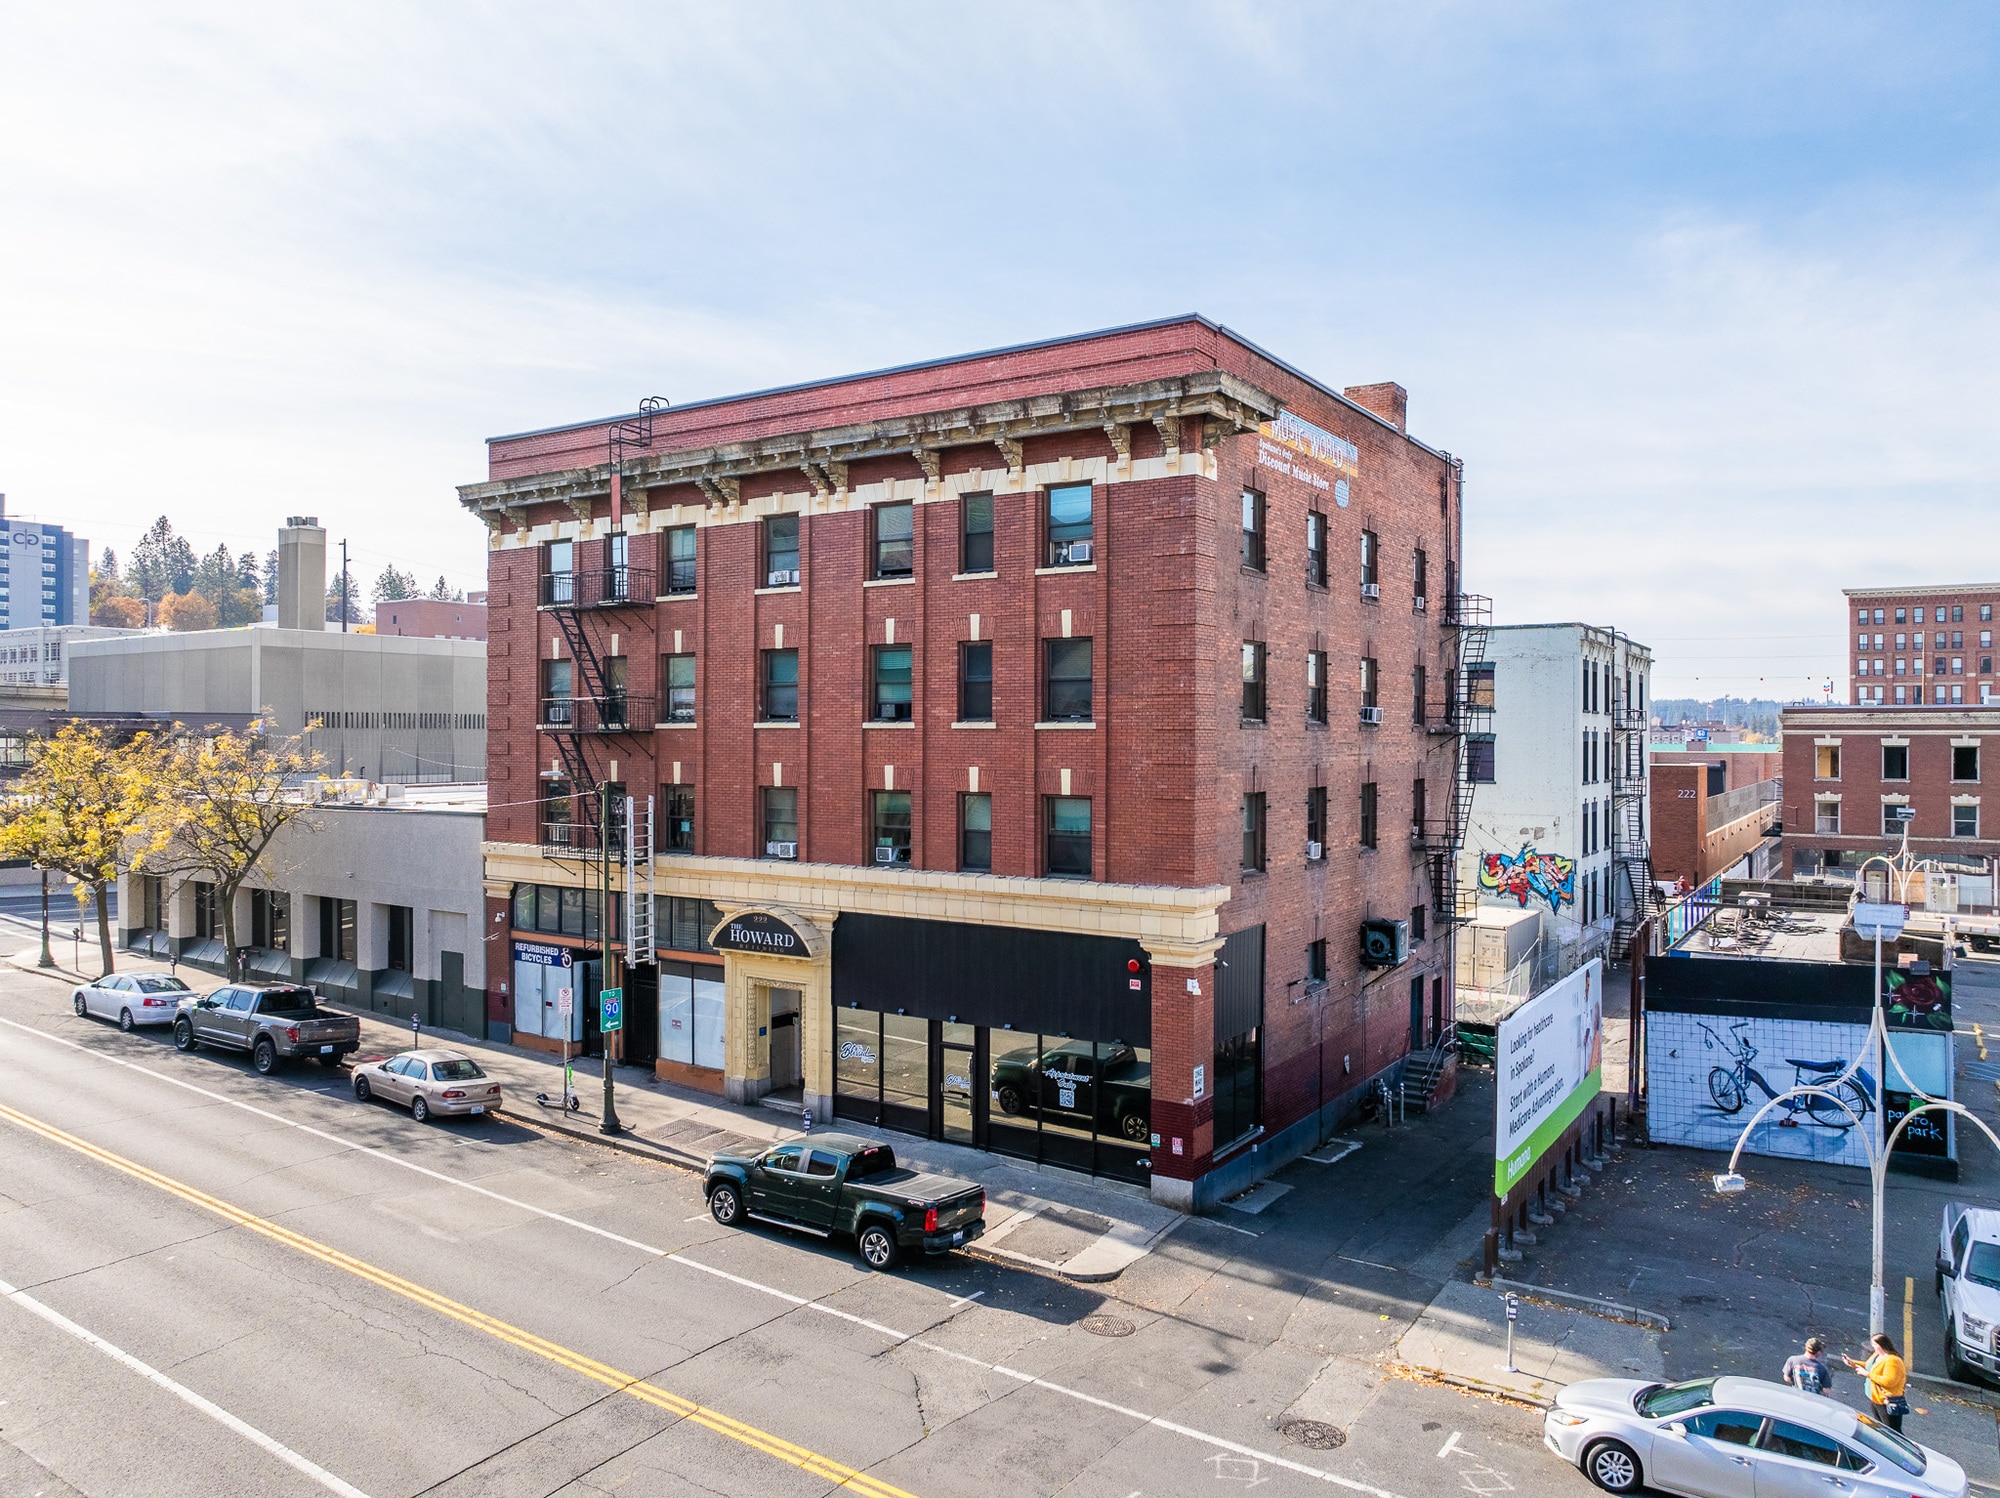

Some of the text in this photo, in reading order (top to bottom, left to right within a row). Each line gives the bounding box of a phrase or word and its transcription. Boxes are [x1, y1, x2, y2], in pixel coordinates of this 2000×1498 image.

[1271, 417, 1343, 469] MUSIC WORLD
[1281, 448, 1293, 462] Only
[1259, 448, 1329, 490] Discount Music Store
[1677, 789, 1696, 799] 222
[753, 915, 768, 923] 222
[730, 929, 794, 948] HOWARD
[515, 942, 559, 956] REFURBISHED
[740, 944, 784, 953] BUILDING
[521, 952, 552, 965] BICYCLES
[605, 1002, 619, 1015] 90
[1510, 1032, 1527, 1055] Looking
[1533, 1013, 1553, 1037] healthcare
[1510, 1048, 1535, 1081] in Spokane?
[1045, 1068, 1090, 1083] Appointment
[1510, 1090, 1522, 1113] Start
[1523, 1079, 1534, 1101] with
[1537, 1063, 1555, 1088] Humana
[1509, 1108, 1531, 1138] Medicare
[1532, 1086, 1554, 1117] Advantage
[1912, 1114, 1929, 1126] to
[1907, 1122, 1943, 1140] park
[1507, 1146, 1531, 1182] Humana
